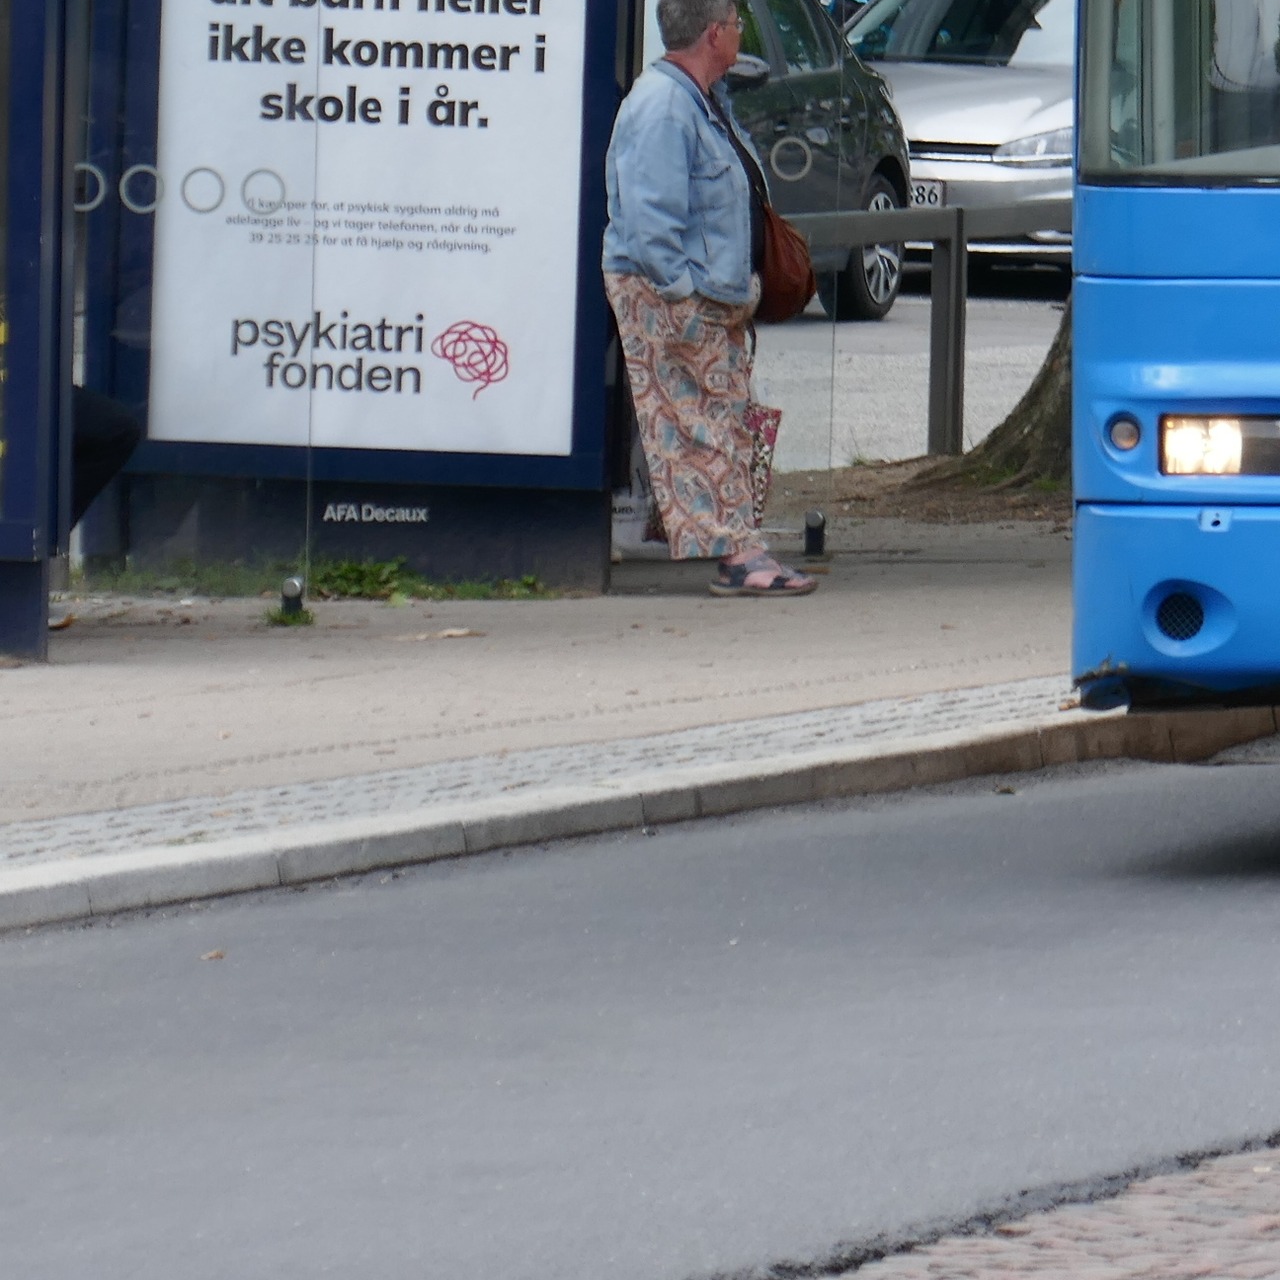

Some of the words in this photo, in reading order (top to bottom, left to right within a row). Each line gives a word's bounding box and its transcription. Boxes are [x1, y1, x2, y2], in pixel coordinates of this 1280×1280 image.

[207, 22, 306, 63] ikke
[322, 27, 521, 72] kommer
[534, 33, 546, 73] i
[260, 82, 382, 124] skole
[398, 86, 411, 126] i
[426, 84, 489, 129] år.
[333, 202, 346, 210] at
[347, 202, 389, 214] psykisk
[393, 204, 441, 217] sygdom
[444, 205, 478, 219] aldrig
[481, 206, 500, 217] må
[286, 216, 301, 226] liv
[344, 219, 375, 230] tager
[378, 220, 437, 233] telefonen,
[441, 222, 460, 233] når
[464, 223, 477, 234] du
[481, 225, 517, 238] ringer
[322, 235, 338, 246] for
[341, 236, 353, 246] at
[356, 236, 368, 246] få
[371, 236, 404, 250] hjælp
[407, 240, 423, 251] og
[427, 239, 492, 254] rådgivning.
[230, 311, 425, 358] psykiatri
[263, 352, 422, 394] fonden
[323, 503, 356, 522] AFA
[361, 504, 429, 523] Decaux
